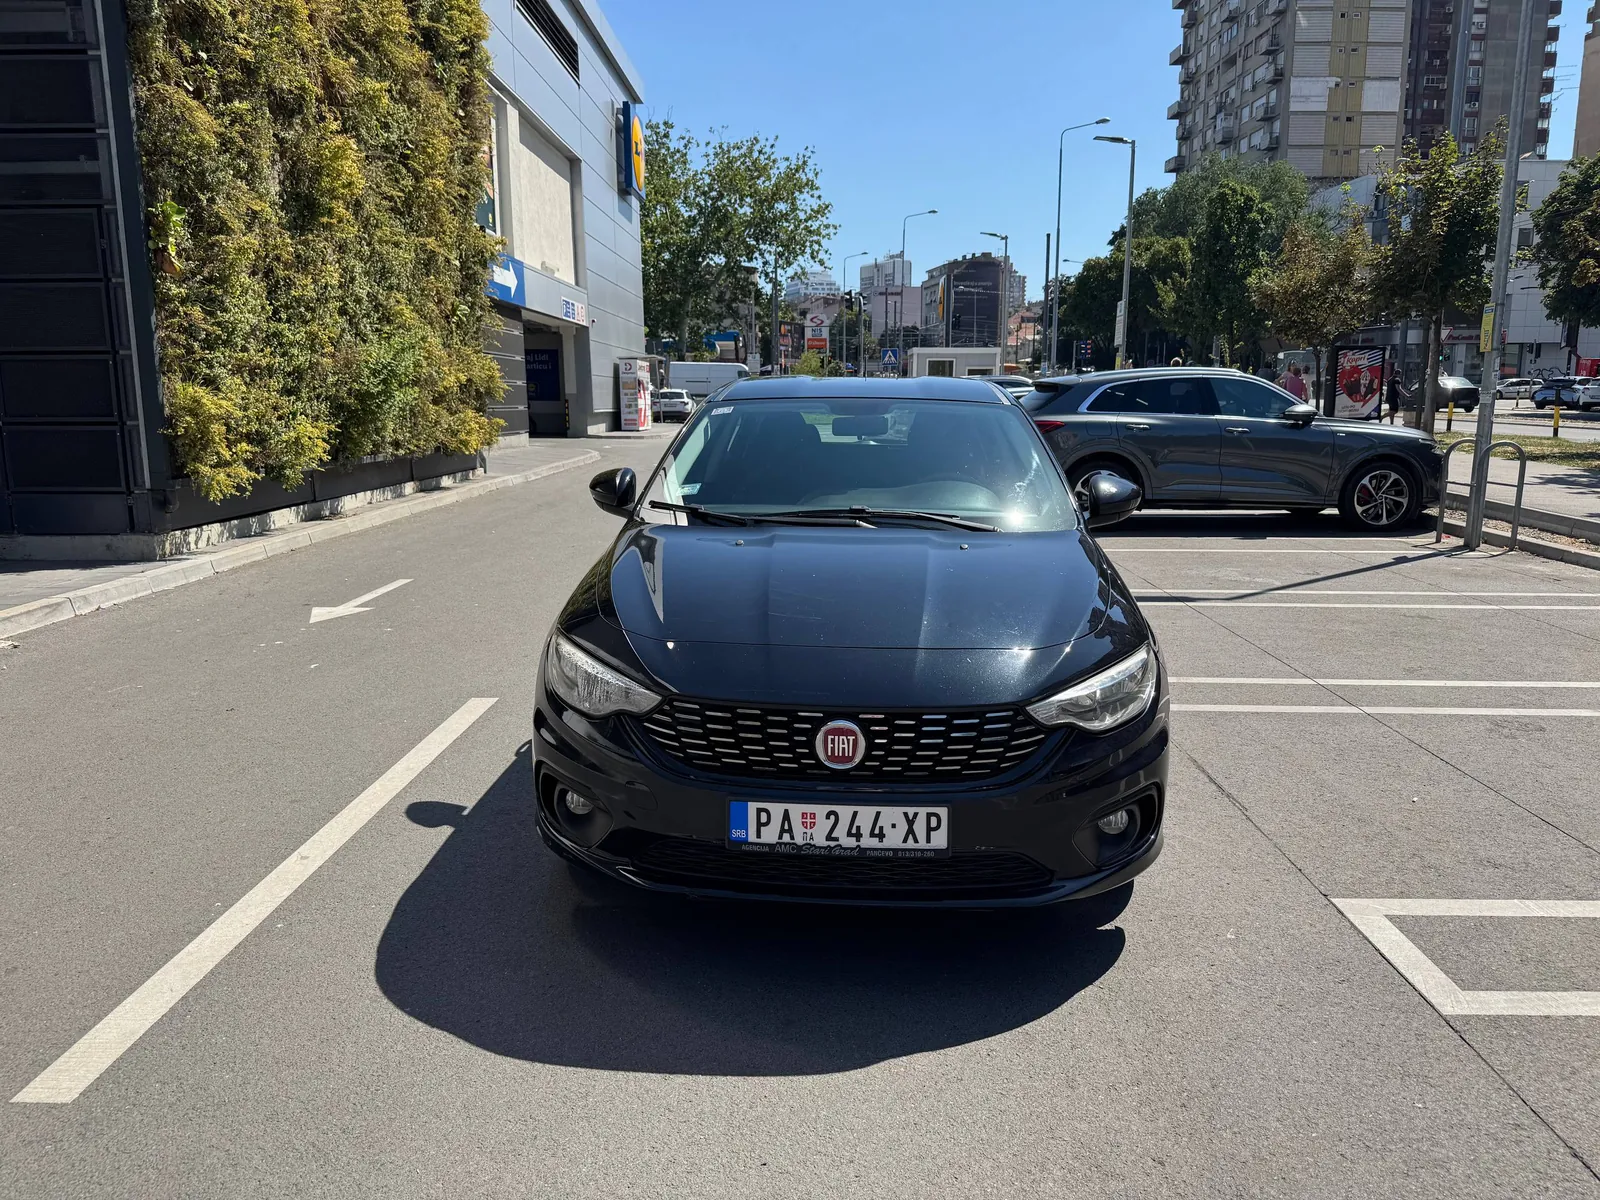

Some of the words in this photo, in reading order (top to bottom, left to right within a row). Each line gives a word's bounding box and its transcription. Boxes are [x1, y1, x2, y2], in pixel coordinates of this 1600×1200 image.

[534, 353, 549, 361] Lidl
[827, 734, 856, 757] FIAT
[755, 807, 796, 841] PA
[731, 828, 747, 838] SRB
[741, 844, 769, 852] AGENCIJA
[774, 844, 797, 853] AMC
[800, 845, 830, 855] Stari
[831, 846, 860, 856] Grad
